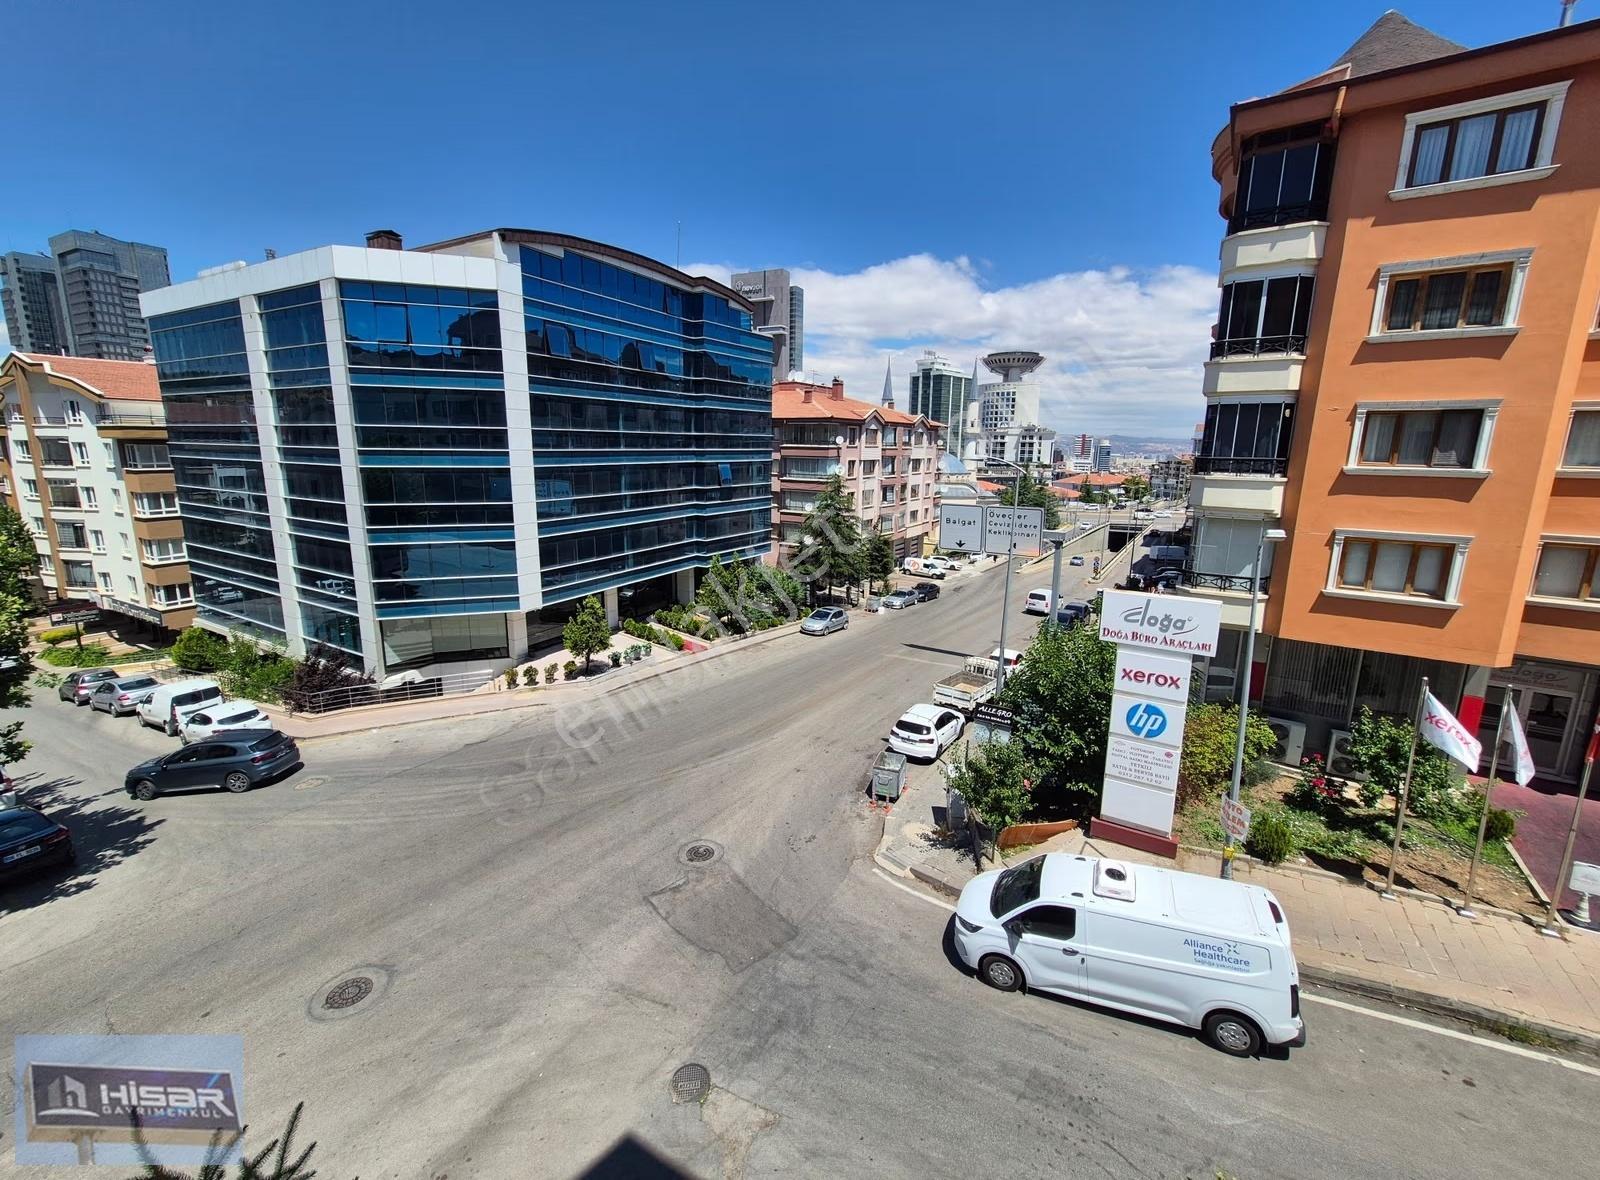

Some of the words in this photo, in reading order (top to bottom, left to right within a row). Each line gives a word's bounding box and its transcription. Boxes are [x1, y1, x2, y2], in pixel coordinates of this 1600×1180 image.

[945, 517, 977, 527] Balgat
[988, 509, 1028, 521] Öveçer
[988, 520, 1038, 530] Cevizidere
[1121, 668, 1181, 690] xerox
[978, 705, 1013, 718] ALLEGRO
[1130, 703, 1164, 738] hp
[1424, 710, 1472, 752] xerox
[1183, 938, 1224, 953] Alliance
[1193, 949, 1250, 967] Healthcare
